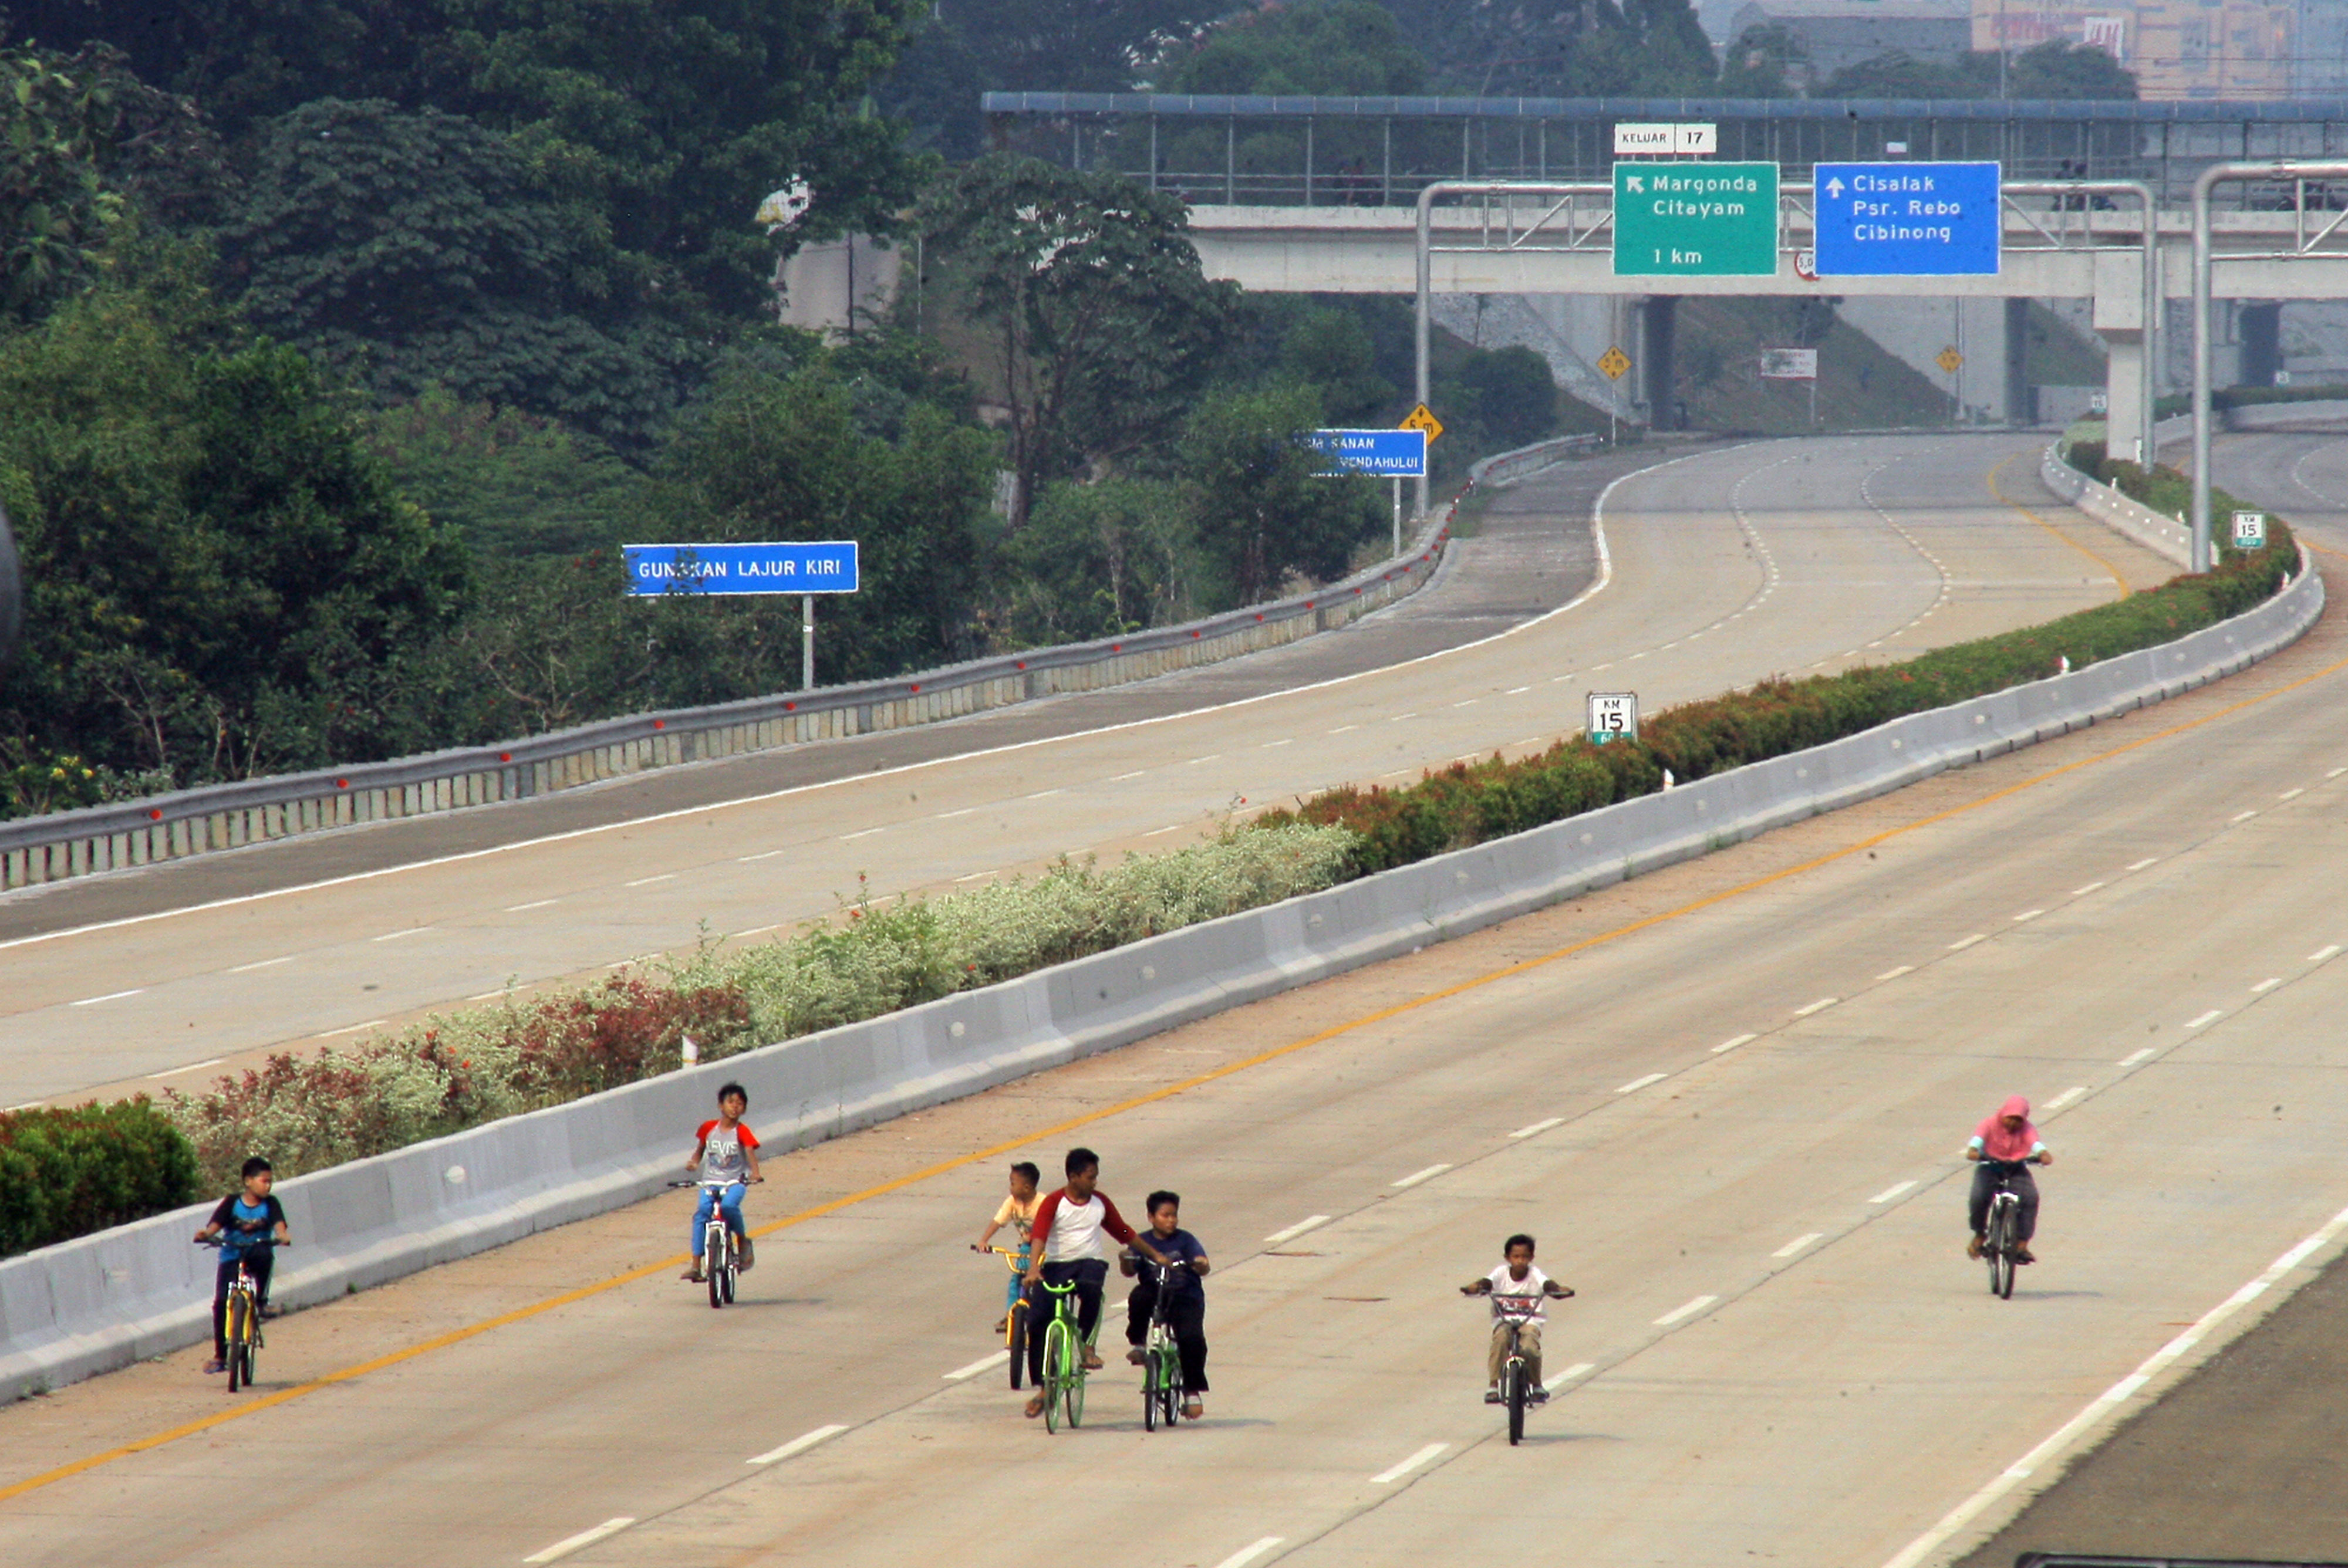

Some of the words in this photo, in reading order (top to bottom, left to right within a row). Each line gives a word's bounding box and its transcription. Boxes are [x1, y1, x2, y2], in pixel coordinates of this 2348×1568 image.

[1622, 133, 1667, 143] KELUAR
[1686, 131, 1703, 144] 17
[1653, 175, 1757, 195] Margonda
[1853, 174, 1935, 192] Cisalak
[1653, 200, 1745, 219] Citayam
[1853, 200, 1898, 217] Psr.
[1908, 200, 1961, 216] Rebo
[1854, 224, 1952, 243] Cibinong
[1654, 248, 1661, 263] 1
[1671, 248, 1702, 264] km
[2241, 524, 2256, 536] 15
[738, 560, 795, 576] LAJUR
[806, 559, 841, 575] KIRI
[1603, 699, 1621, 709] KM
[1599, 712, 1624, 731] 15
